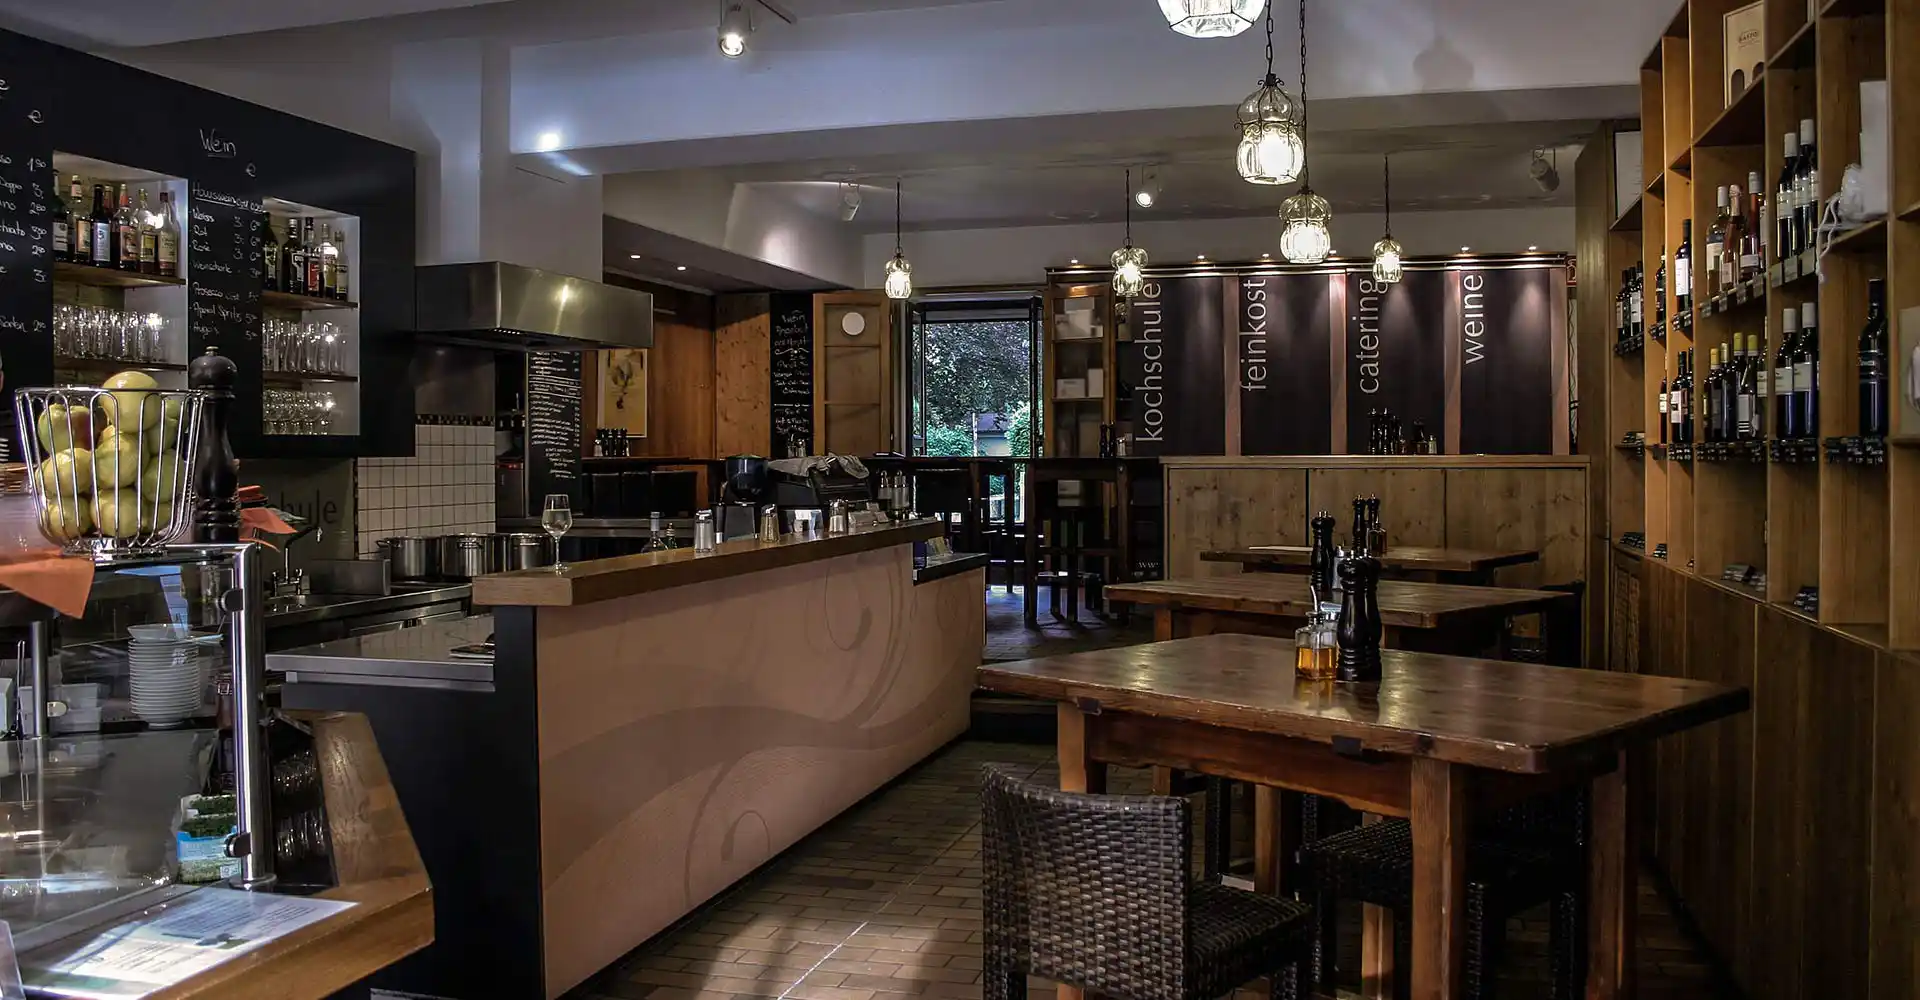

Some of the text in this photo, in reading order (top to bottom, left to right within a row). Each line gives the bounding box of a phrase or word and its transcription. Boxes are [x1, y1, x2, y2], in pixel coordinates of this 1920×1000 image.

[1133, 282, 1164, 442] kochschule
[1239, 279, 1268, 392] feinkost
[1352, 277, 1389, 394] catering
[1463, 273, 1485, 365] weine
